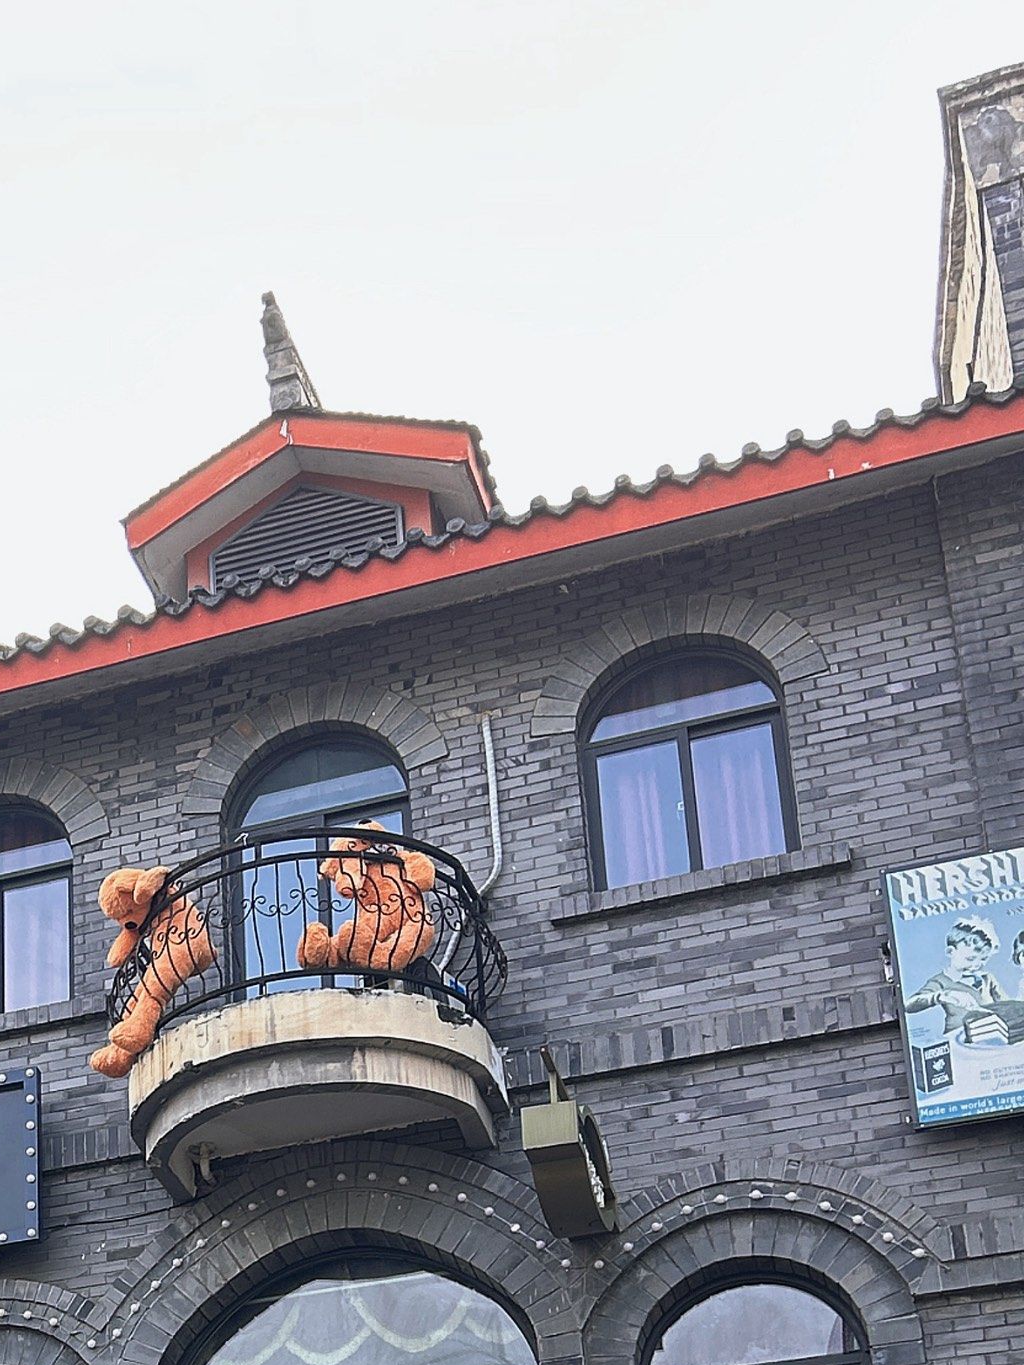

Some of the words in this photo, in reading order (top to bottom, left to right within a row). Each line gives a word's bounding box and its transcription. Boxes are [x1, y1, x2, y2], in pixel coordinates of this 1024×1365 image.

[920, 1107, 946, 1117] Made
[949, 1104, 958, 1113] in
[960, 1098, 994, 1111] world's
[997, 1094, 1024, 1107] large
